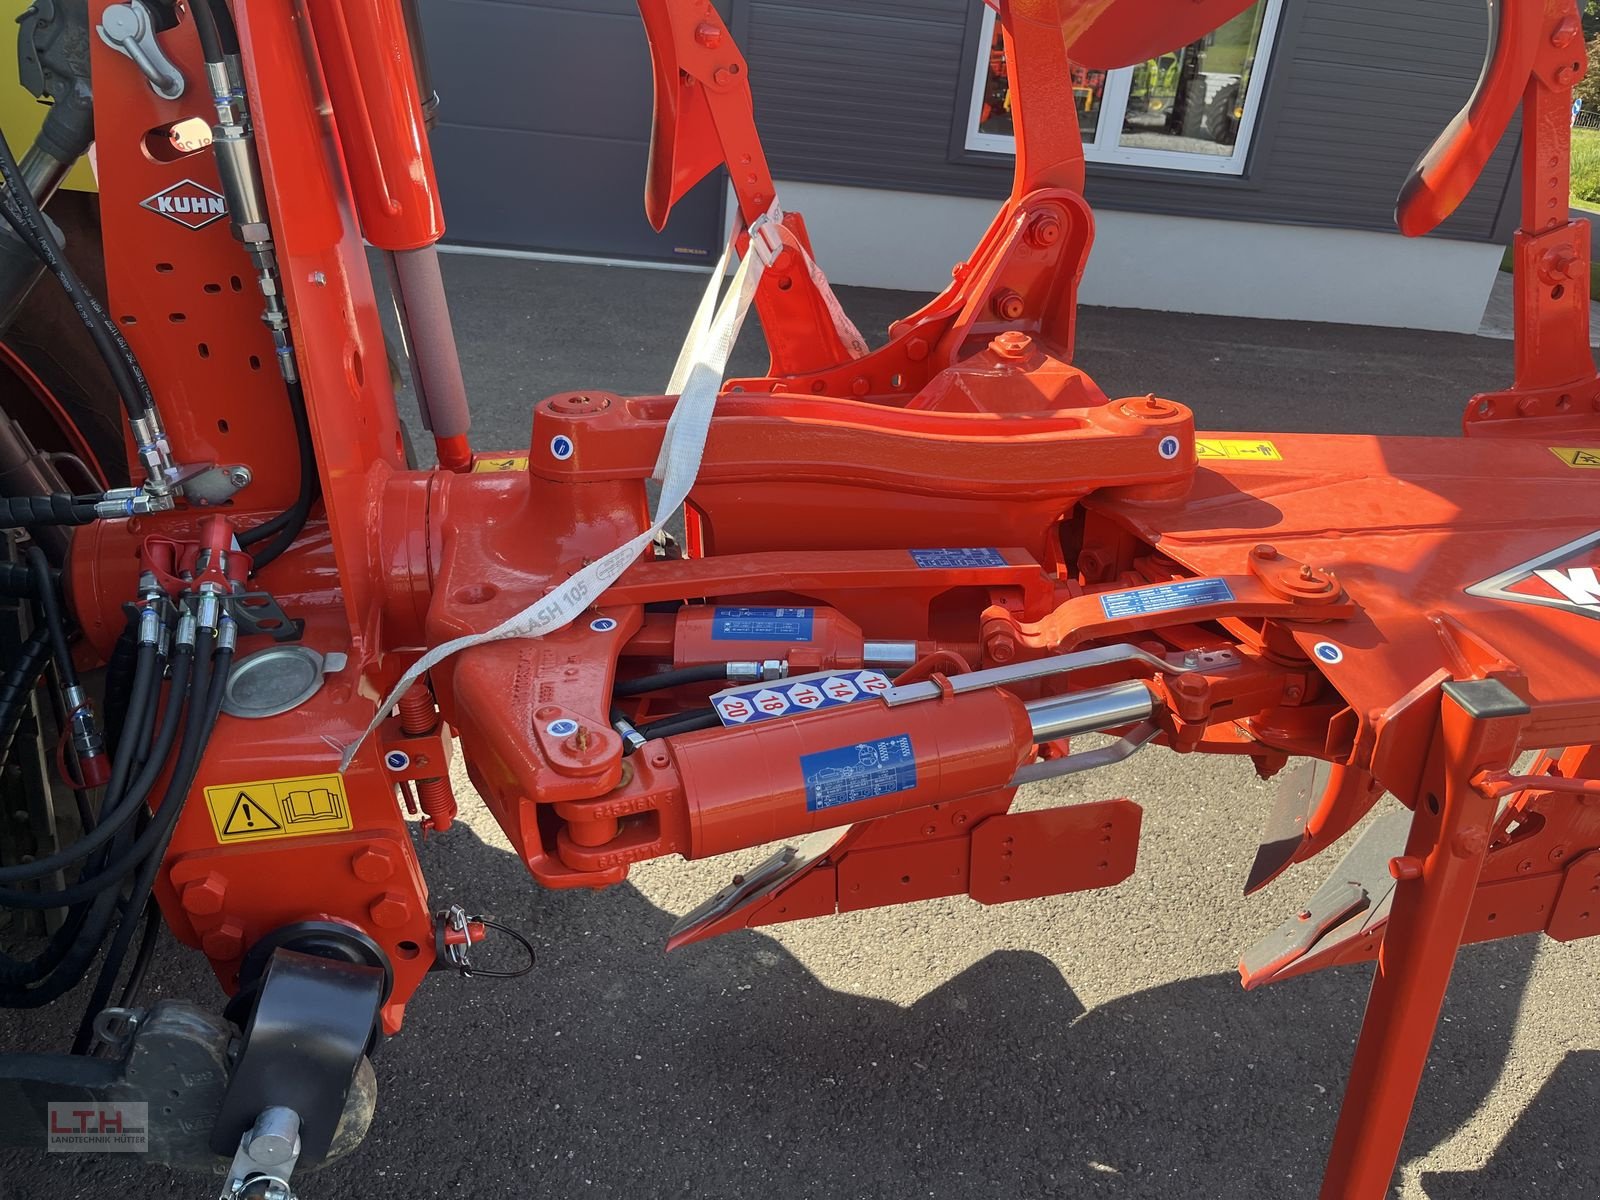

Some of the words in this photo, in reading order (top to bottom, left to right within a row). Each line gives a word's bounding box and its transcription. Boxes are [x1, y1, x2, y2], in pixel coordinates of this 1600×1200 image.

[157, 196, 225, 213] KUHN
[563, 580, 588, 607] 105
[828, 682, 854, 699] 14
[862, 676, 888, 692] 12
[759, 695, 785, 711] 18
[794, 688, 819, 705] 16
[723, 701, 749, 718] 20
